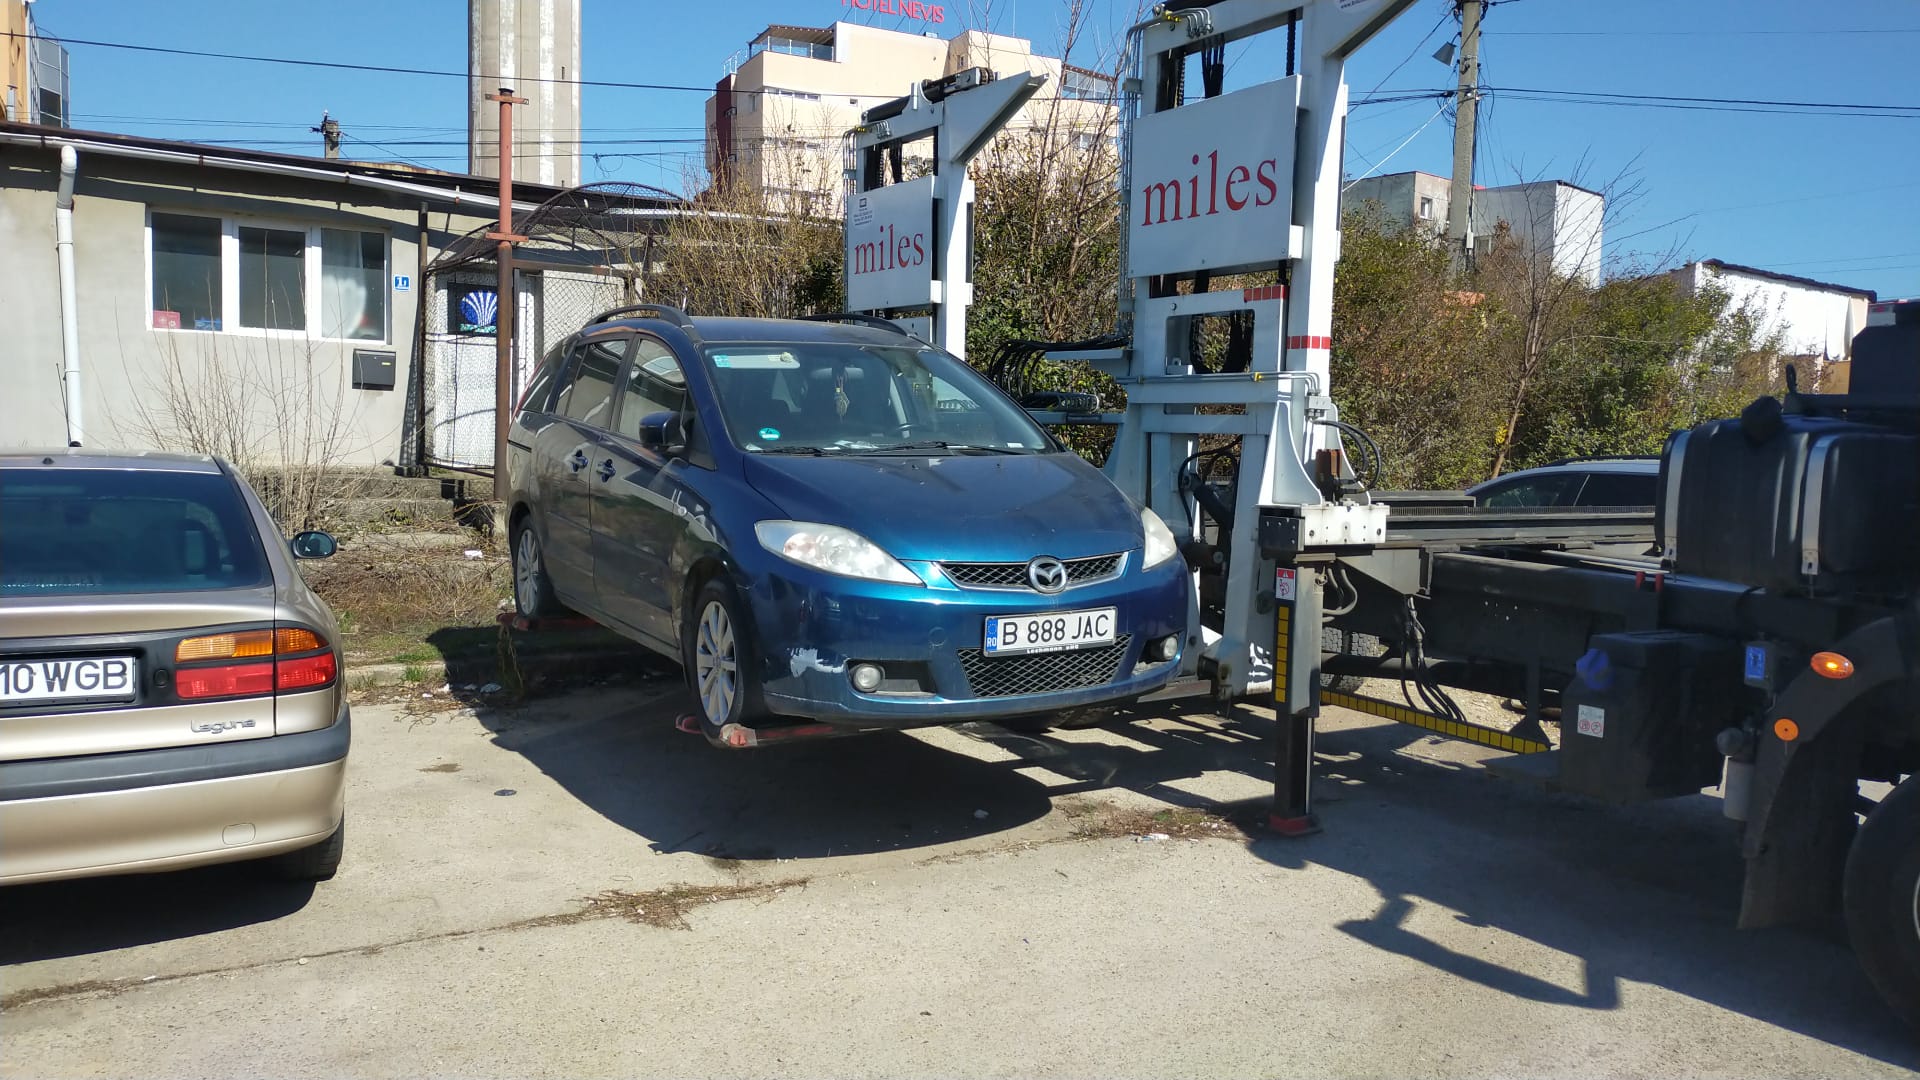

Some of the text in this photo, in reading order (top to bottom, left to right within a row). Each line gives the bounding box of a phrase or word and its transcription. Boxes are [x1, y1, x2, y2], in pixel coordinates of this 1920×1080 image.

[899, 0, 945, 23] NEVIS
[1141, 149, 1278, 227] miles
[854, 223, 925, 275] miles
[986, 637, 997, 648] RO
[1002, 614, 1109, 646] B 888 JAC
[0, 660, 128, 695] 10 WGB
